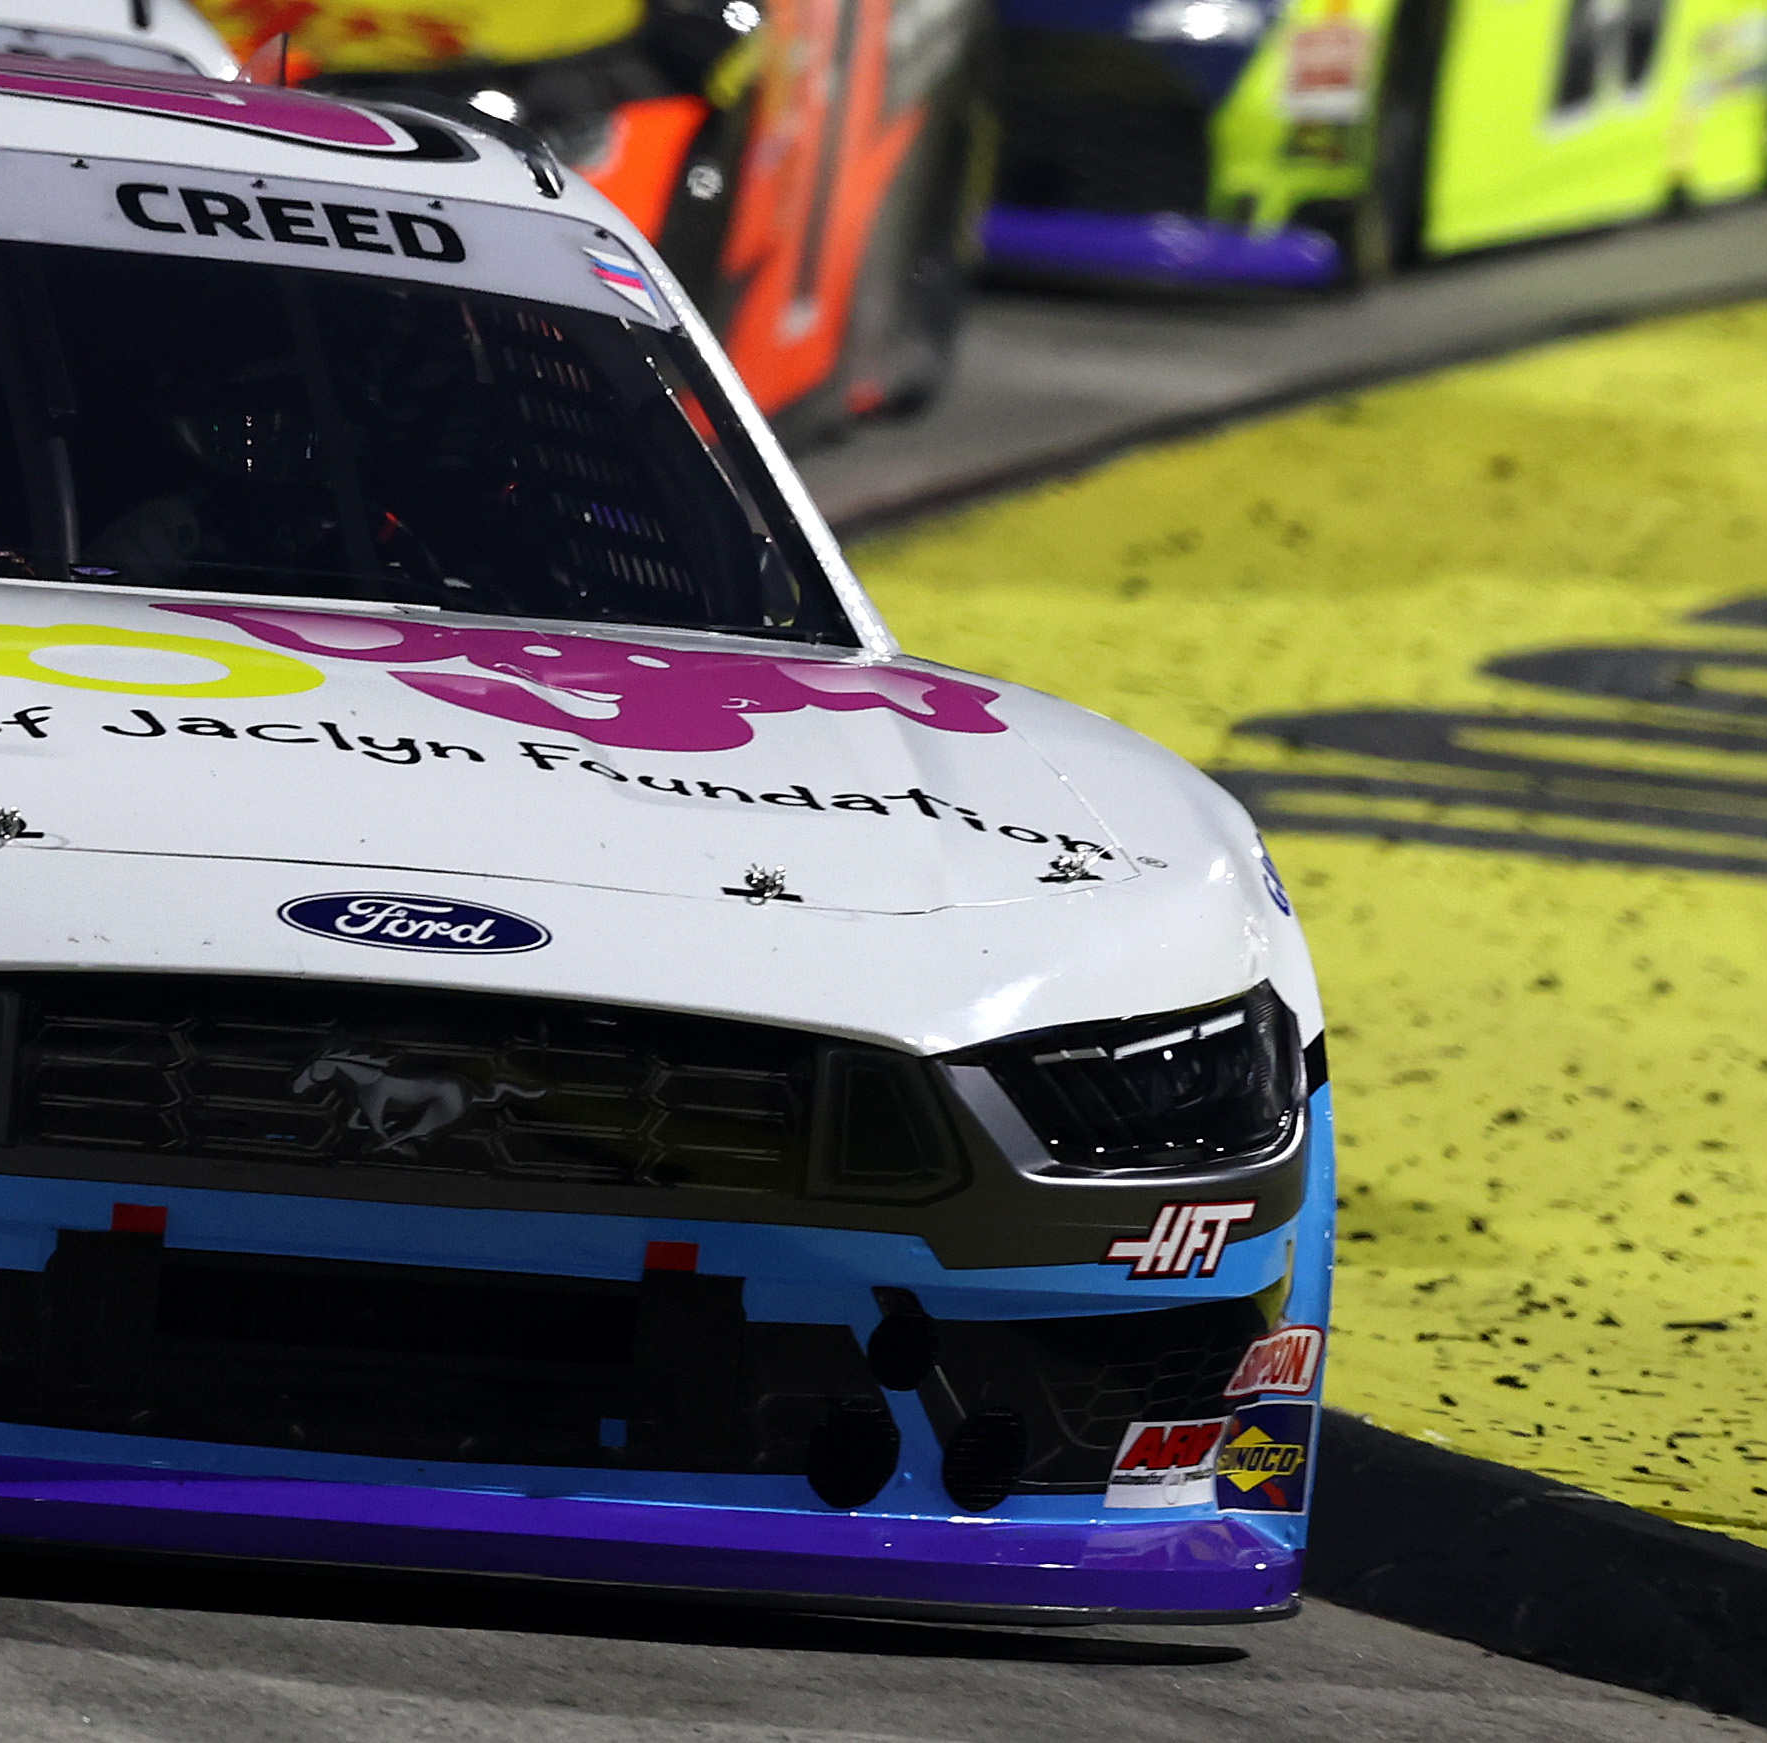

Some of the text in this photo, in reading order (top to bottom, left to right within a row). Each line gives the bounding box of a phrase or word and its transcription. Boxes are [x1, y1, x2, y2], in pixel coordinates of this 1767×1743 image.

[116, 182, 466, 263] CREED
[102, 710, 486, 766] Jaclyn
[334, 894, 497, 948] Ford
[1106, 1201, 1256, 1278] HFT
[1116, 1422, 1223, 1470] ARP
